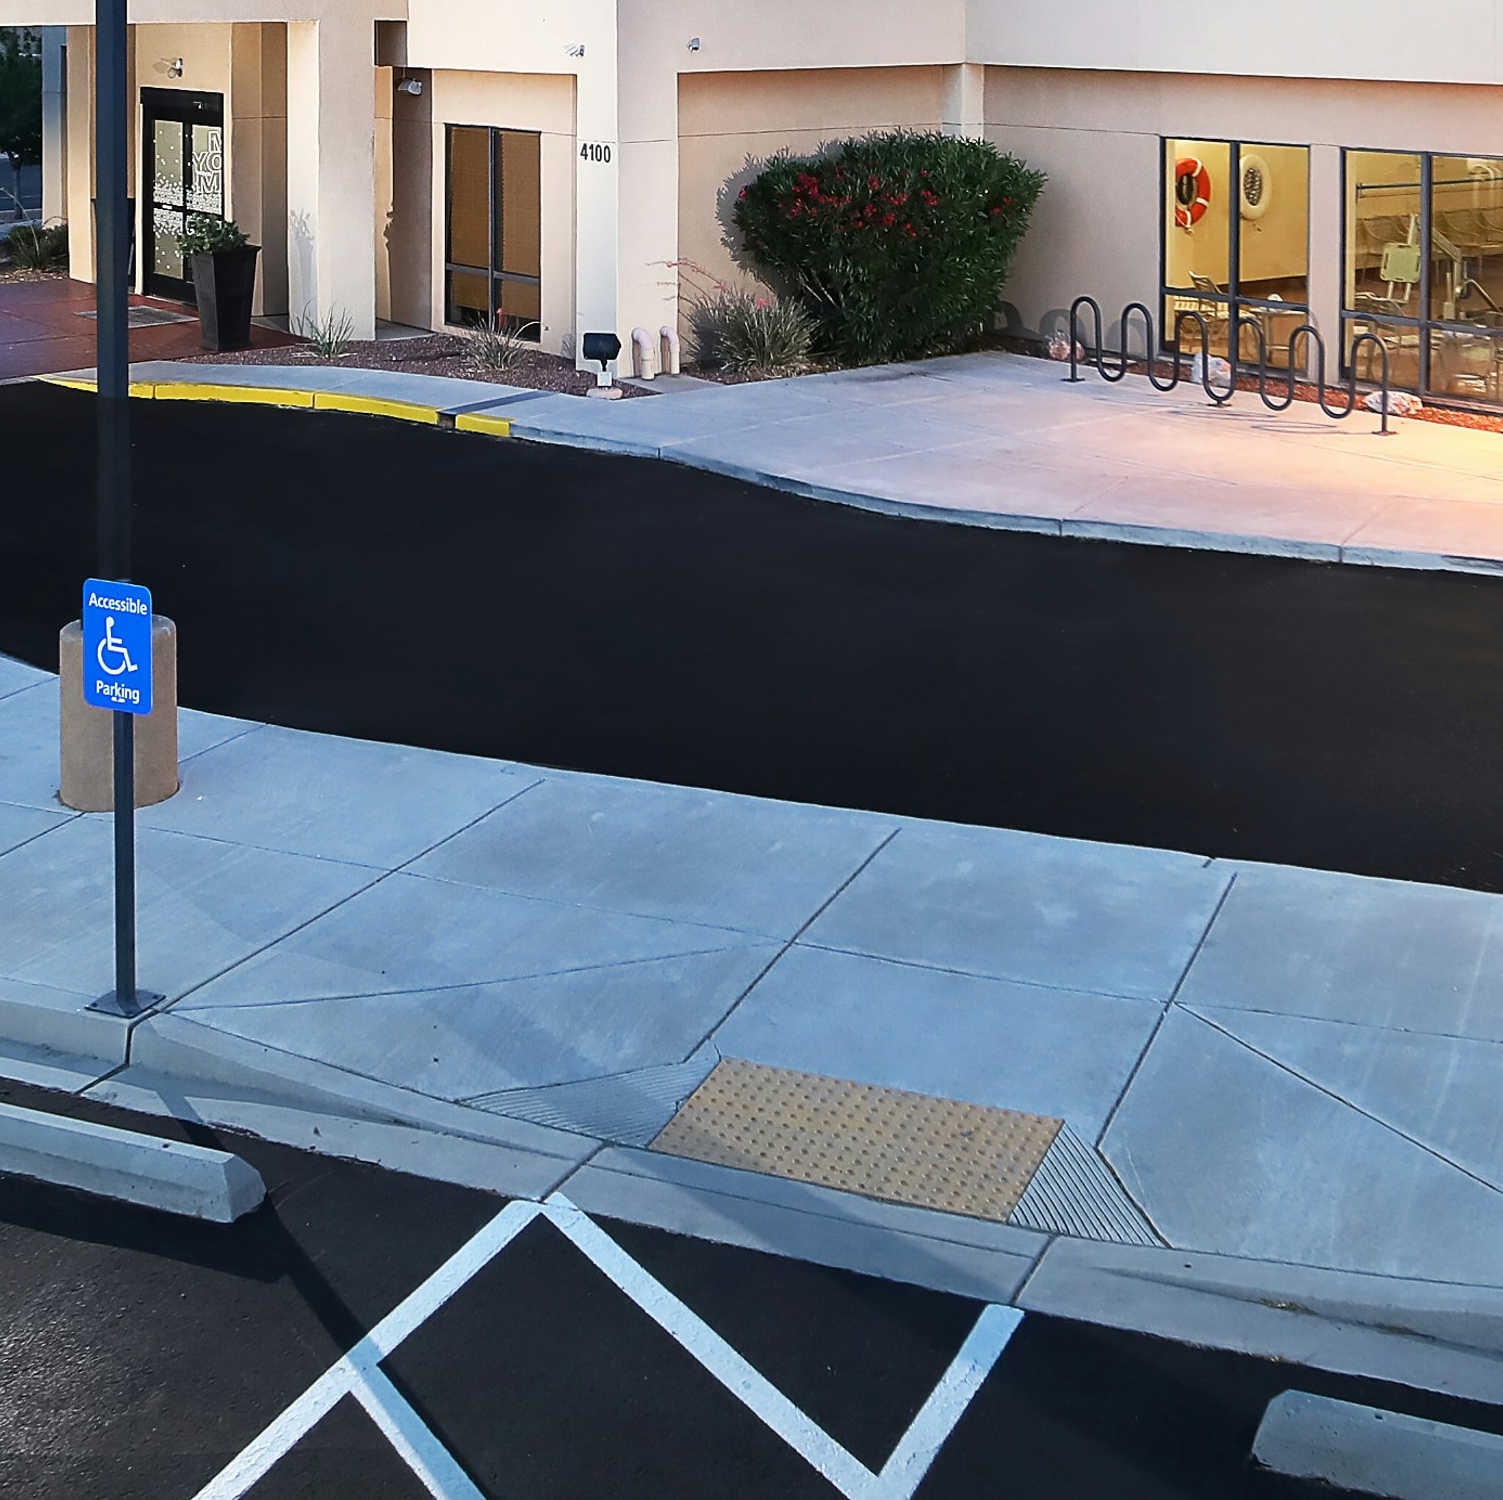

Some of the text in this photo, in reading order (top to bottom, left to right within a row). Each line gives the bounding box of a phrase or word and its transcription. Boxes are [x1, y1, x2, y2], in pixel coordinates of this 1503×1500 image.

[580, 143, 612, 163] 4100
[88, 592, 148, 616] Accessible
[95, 679, 141, 705] Parking
